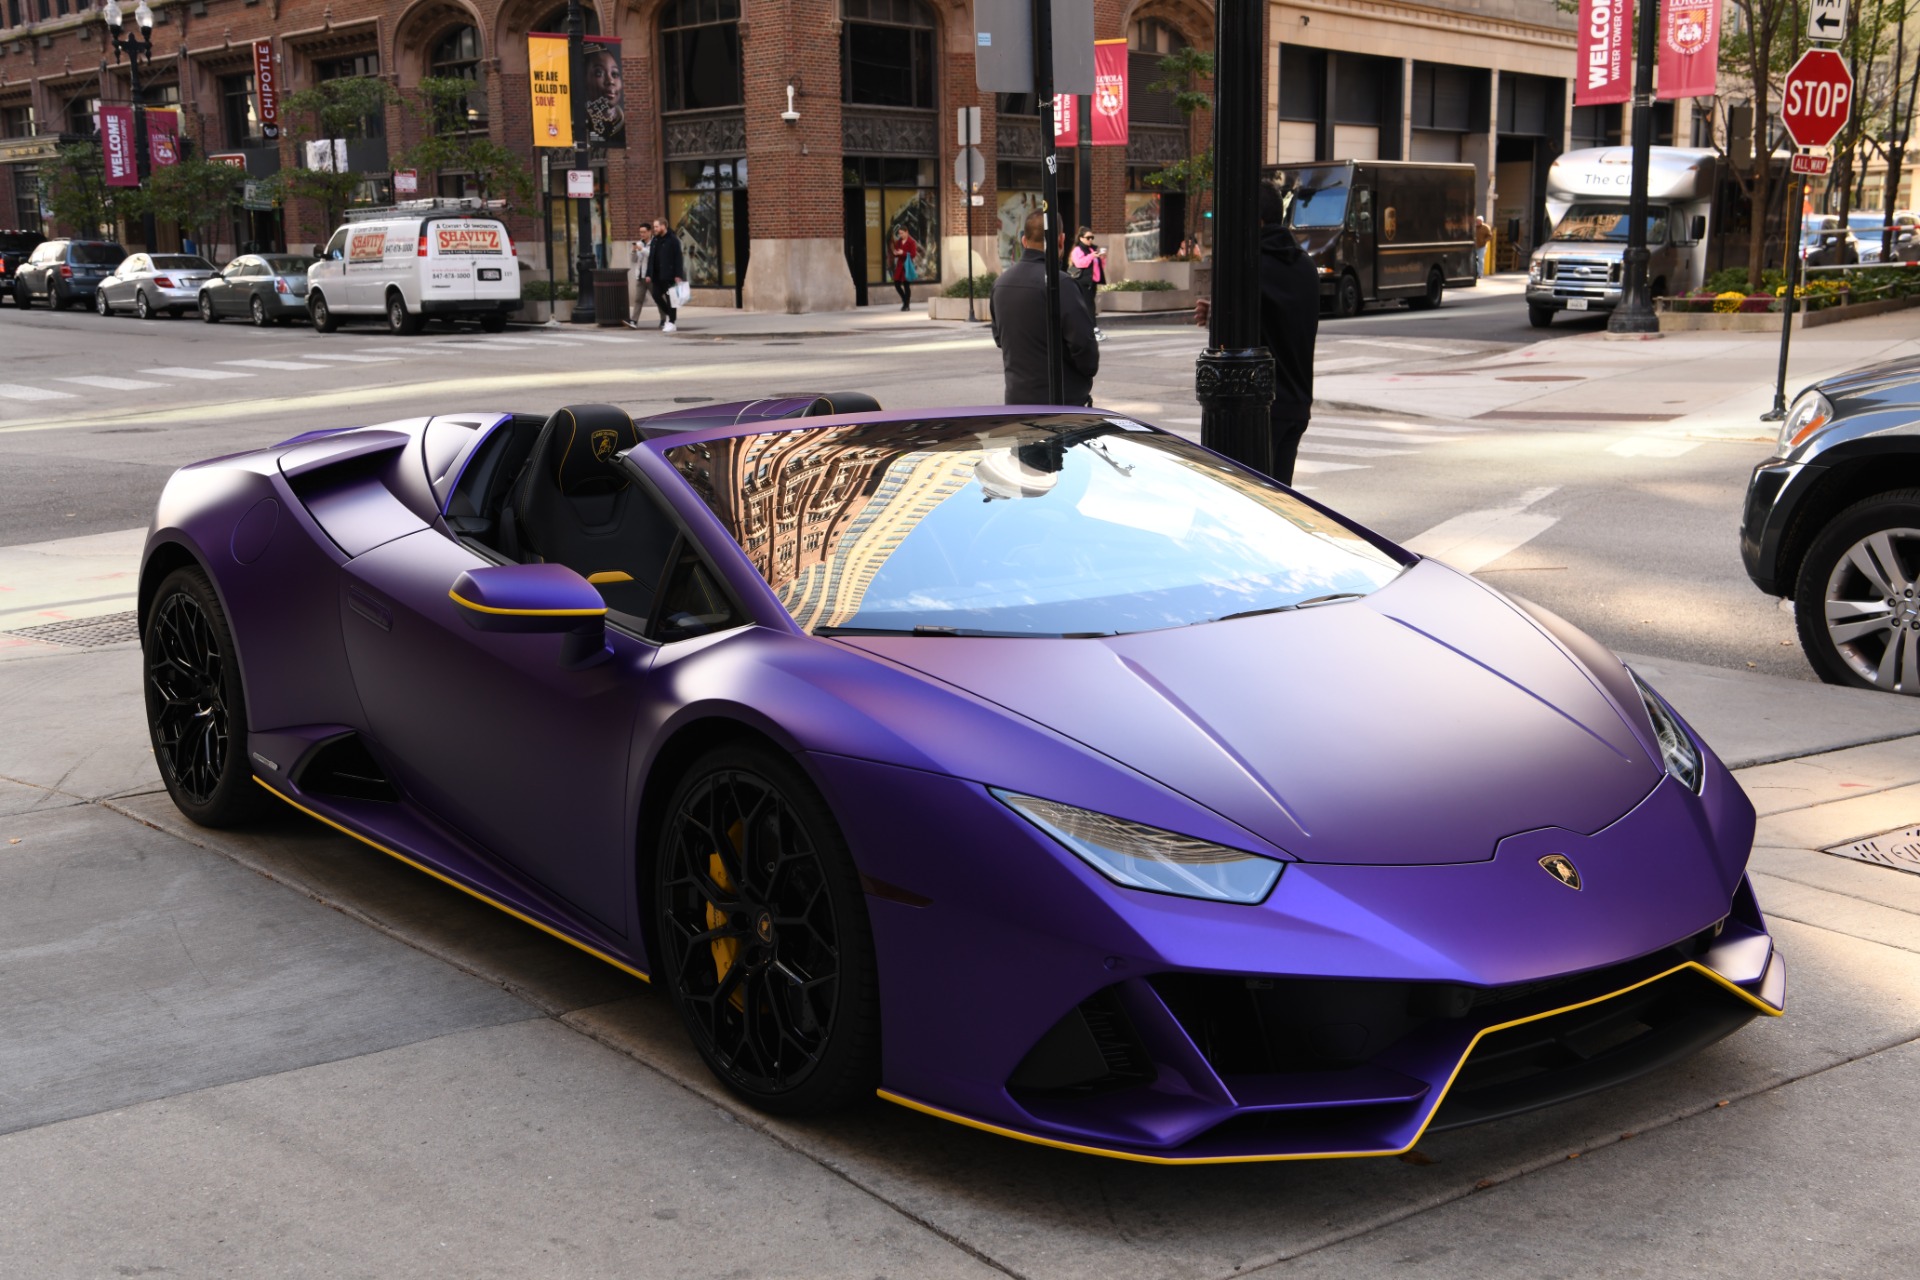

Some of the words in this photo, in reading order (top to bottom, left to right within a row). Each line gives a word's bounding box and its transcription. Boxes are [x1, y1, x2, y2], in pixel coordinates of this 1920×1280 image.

[1614, 0, 1624, 14] CA
[1612, 15, 1623, 48] TOWER
[1611, 49, 1621, 81] WATER
[259, 45, 275, 119] CHIPOTLE
[534, 71, 544, 81] WE
[545, 71, 559, 81] ARE
[1096, 74, 1122, 82] LOYOLA
[534, 84, 558, 94] CALLED
[559, 84, 568, 95] TO
[535, 96, 555, 107] SOLVE
[1786, 79, 1848, 118] STOP
[106, 115, 124, 178] WELCOME
[1795, 157, 1808, 170] ALL
[1810, 159, 1825, 171] WAY
[1585, 174, 1610, 185] The
[351, 233, 384, 256] SHAVITZ
[439, 231, 499, 248] SHAVITZ
